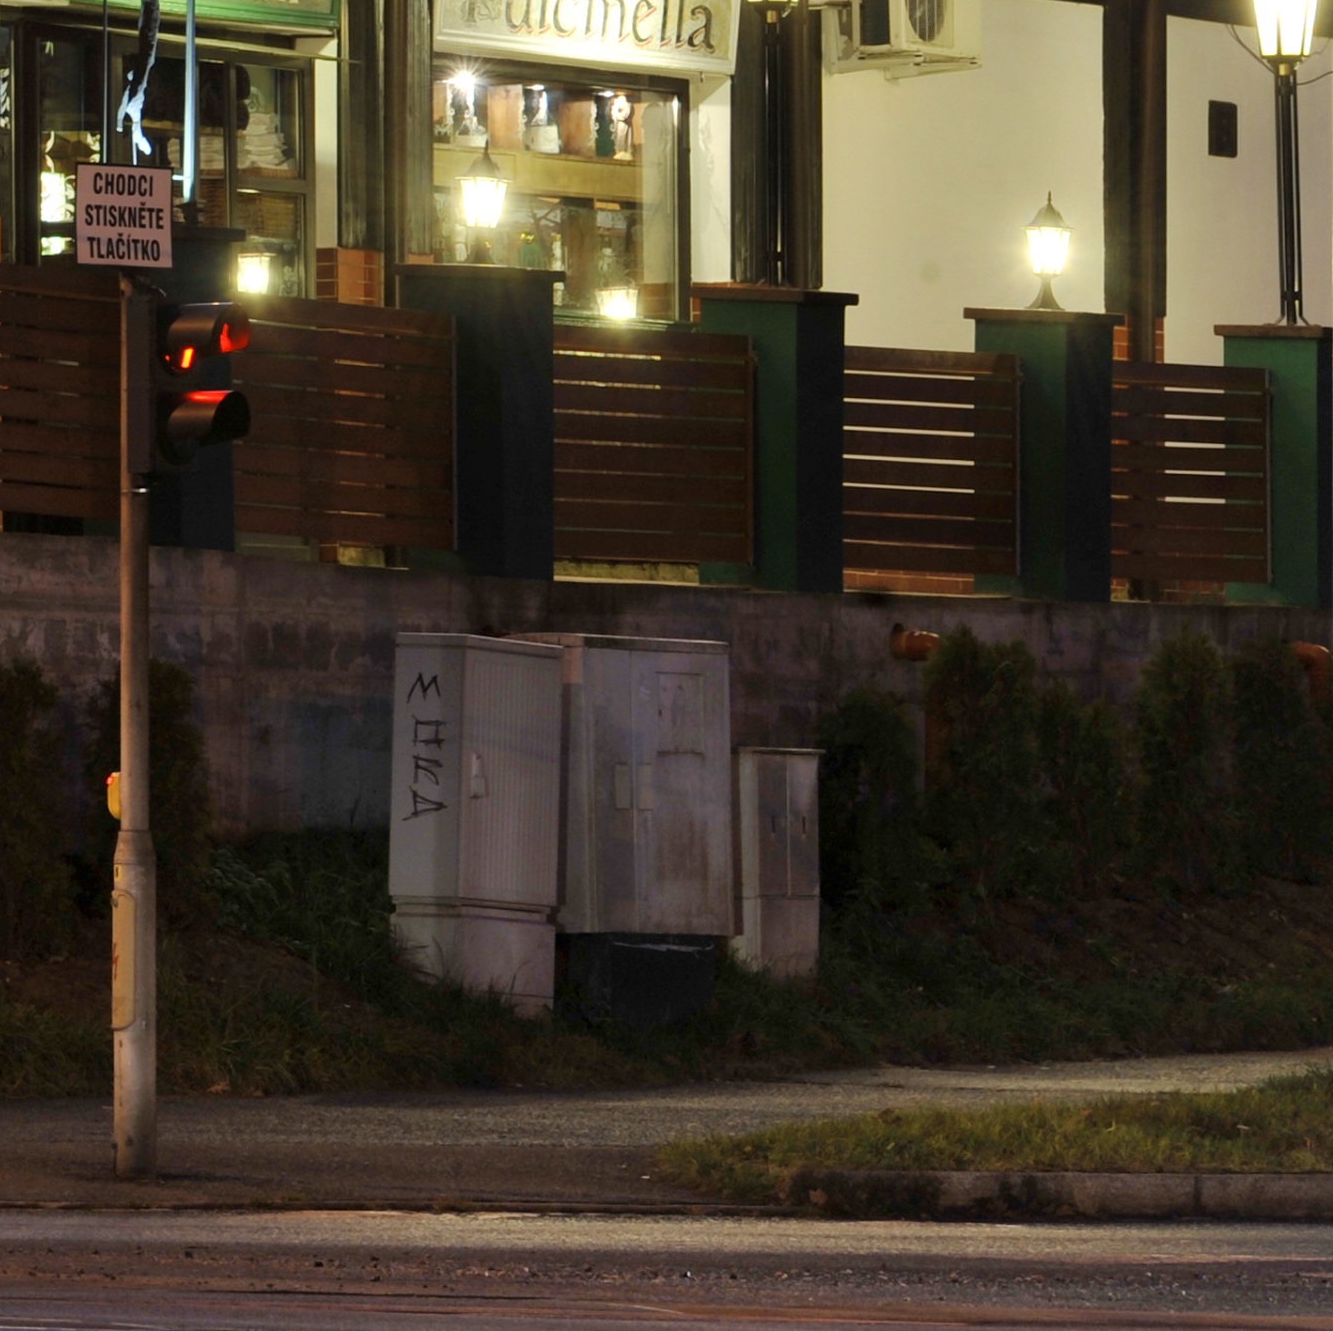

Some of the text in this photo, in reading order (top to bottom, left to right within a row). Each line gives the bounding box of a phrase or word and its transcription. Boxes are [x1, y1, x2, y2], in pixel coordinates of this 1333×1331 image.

[93, 172, 153, 197] CHODCI
[84, 202, 164, 229] STISKNĚTE
[87, 233, 160, 261] TLAČÍTKO
